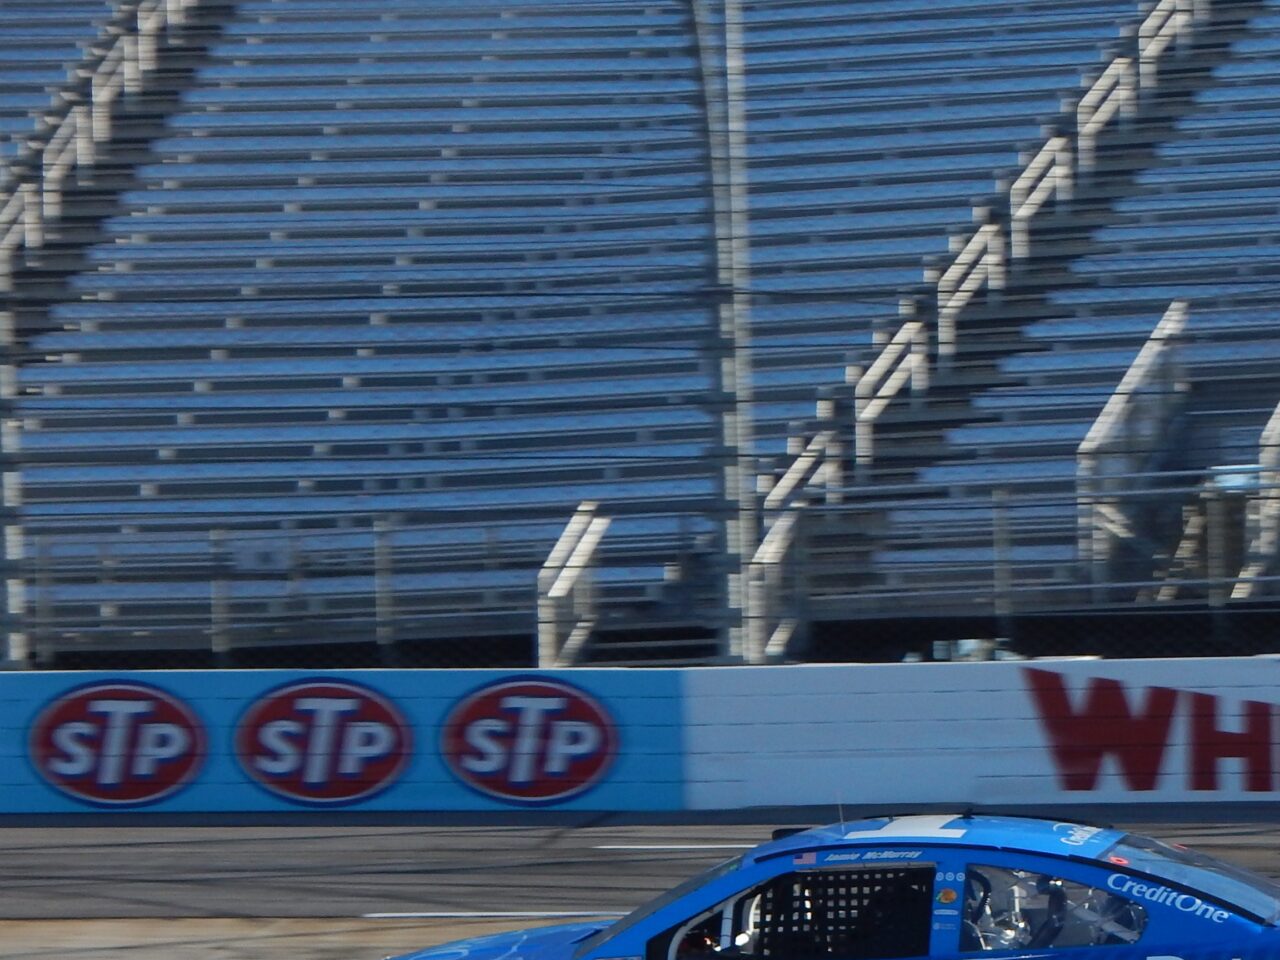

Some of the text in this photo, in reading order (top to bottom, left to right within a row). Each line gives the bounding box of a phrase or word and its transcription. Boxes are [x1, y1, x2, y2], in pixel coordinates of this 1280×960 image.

[48, 699, 191, 786] STP
[254, 698, 397, 785] STP
[459, 696, 602, 784] STP
